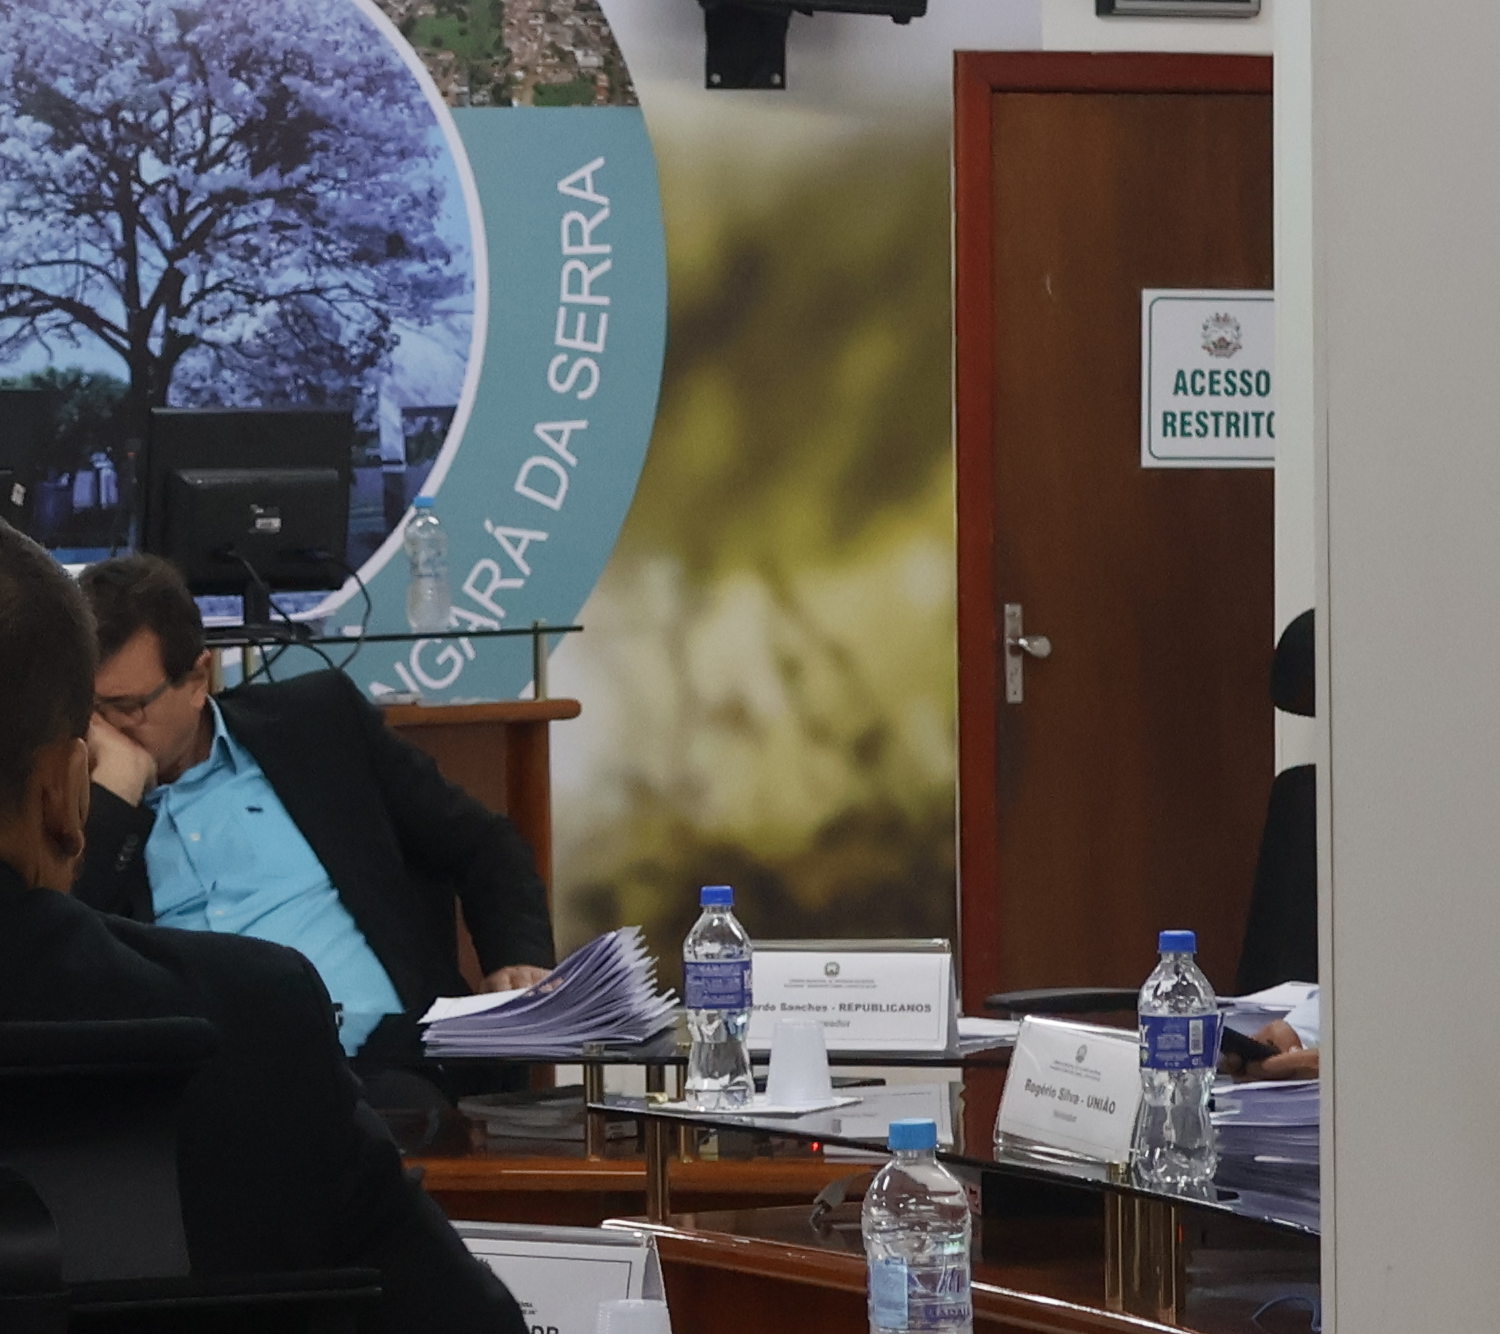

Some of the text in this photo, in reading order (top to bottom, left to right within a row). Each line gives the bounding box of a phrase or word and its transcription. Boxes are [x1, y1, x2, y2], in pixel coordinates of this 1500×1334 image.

[547, 156, 612, 401] SERRA
[1173, 369, 1271, 396] ACESSO
[514, 417, 589, 512] DA
[780, 1003, 827, 1012] Sanches
[839, 1003, 932, 1013] REPUBLICANOS
[1086, 1095, 1116, 1115] UNIÃO
